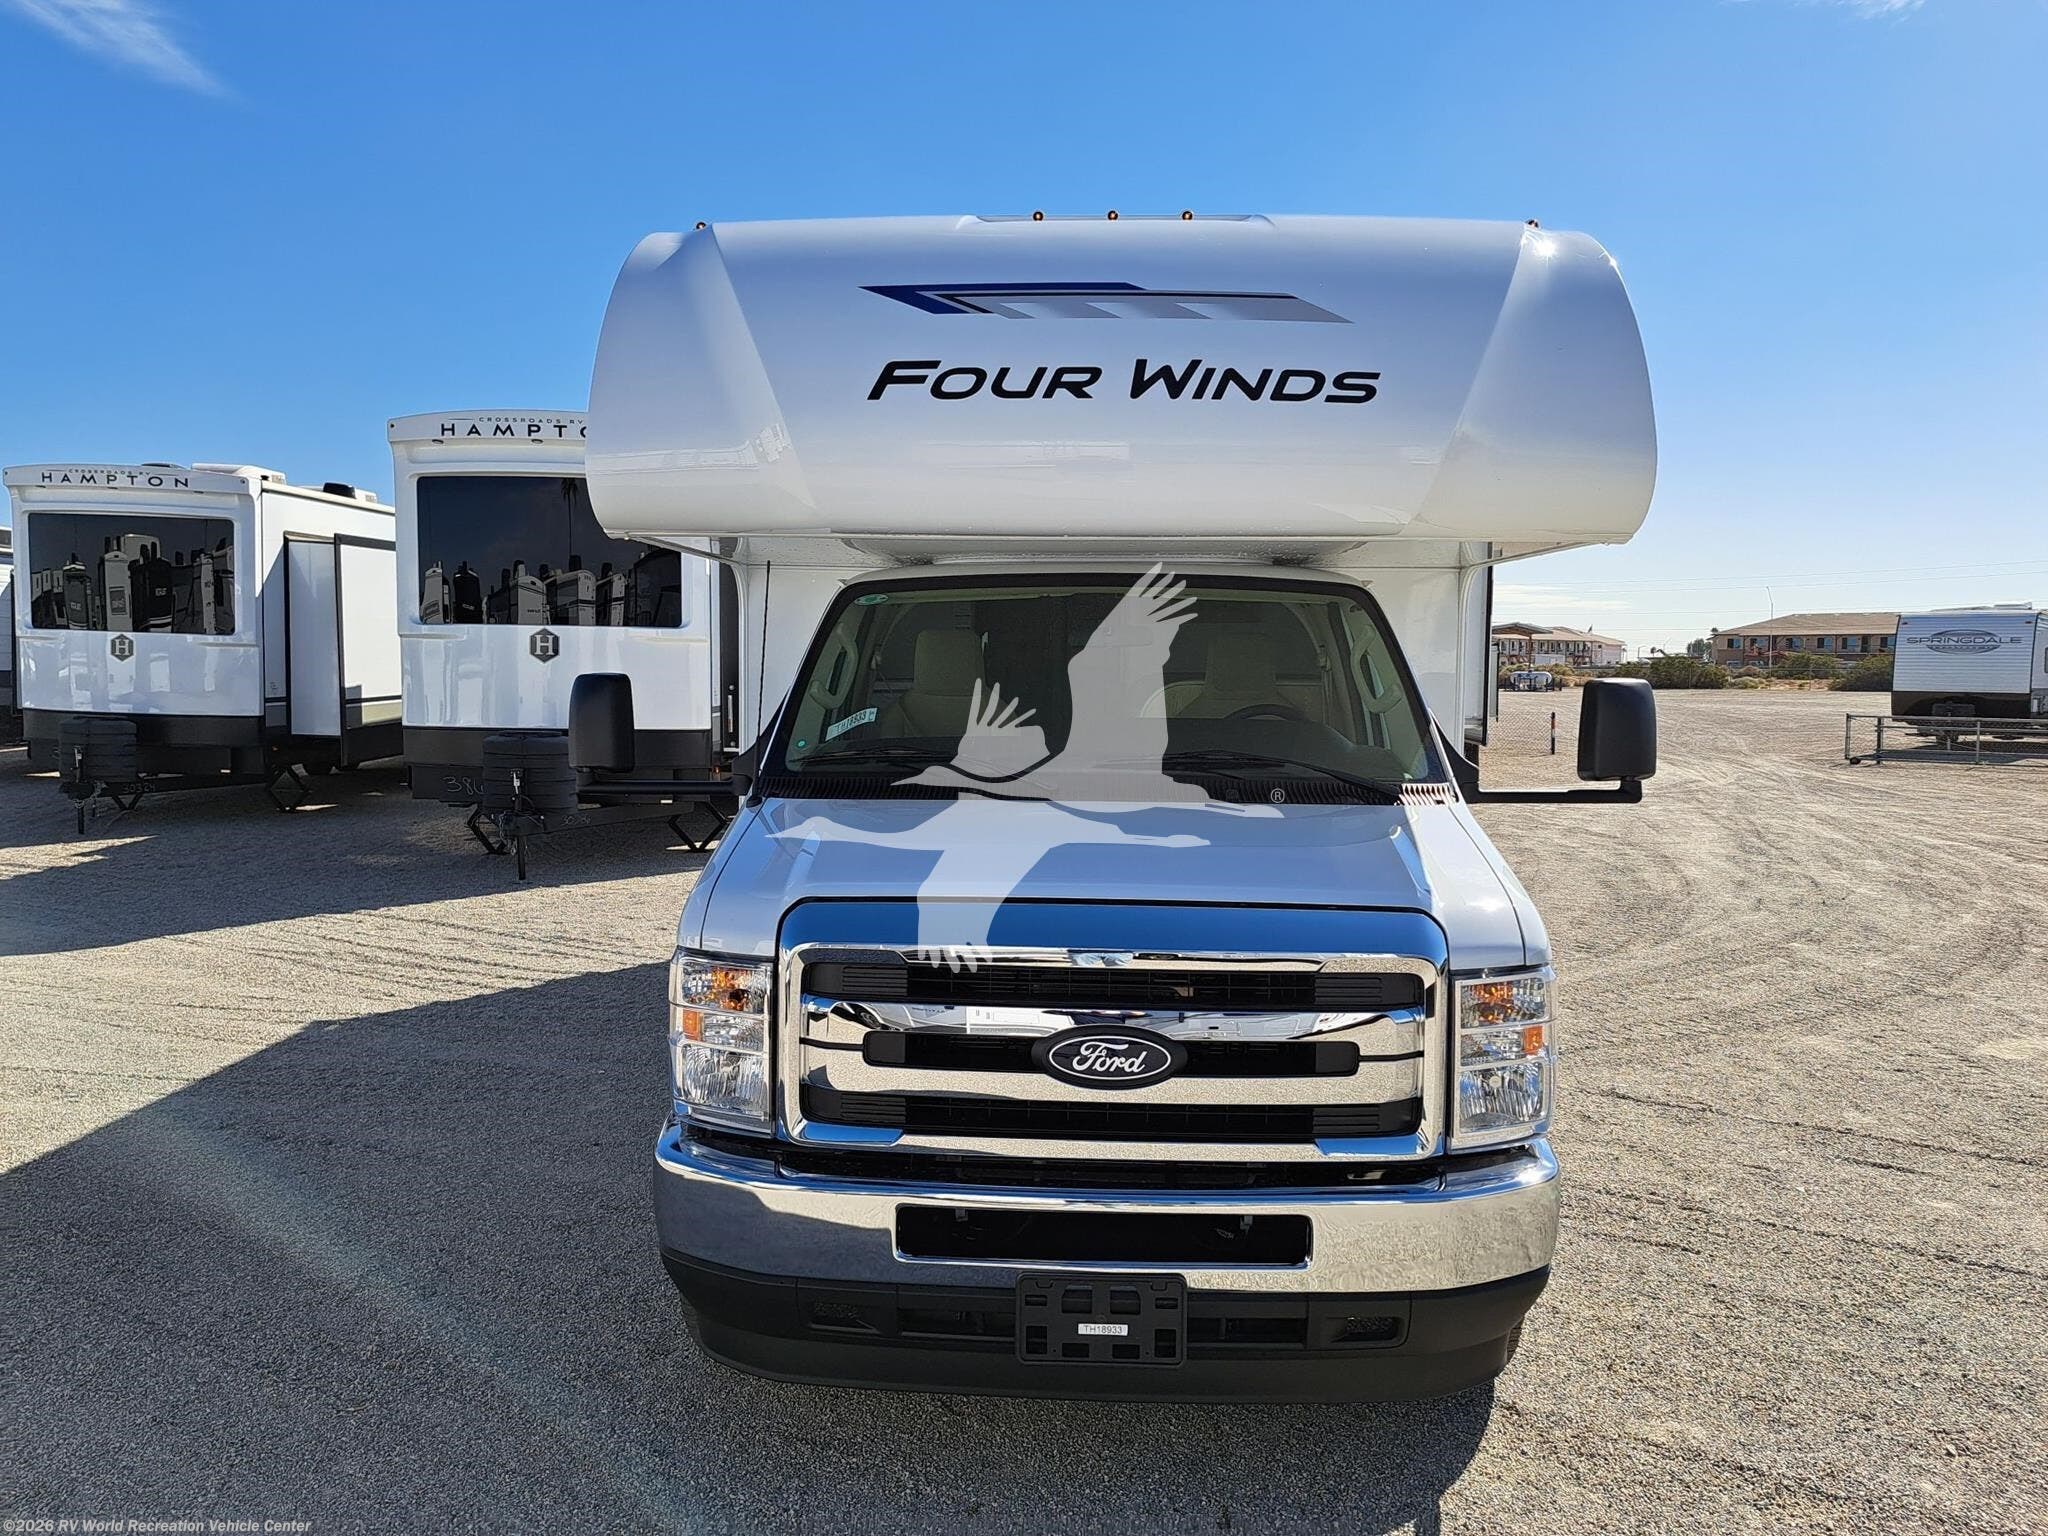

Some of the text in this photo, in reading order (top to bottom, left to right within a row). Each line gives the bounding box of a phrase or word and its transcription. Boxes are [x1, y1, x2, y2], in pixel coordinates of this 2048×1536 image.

[478, 416, 561, 424] CROSSROADS
[41, 471, 189, 488] HAMPTON
[114, 639, 131, 656] H
[534, 634, 555, 656] H
[1906, 636, 2023, 644] SPRINGDALE
[1072, 1041, 1148, 1073] Ford
[1083, 1324, 1123, 1334] TH18933
